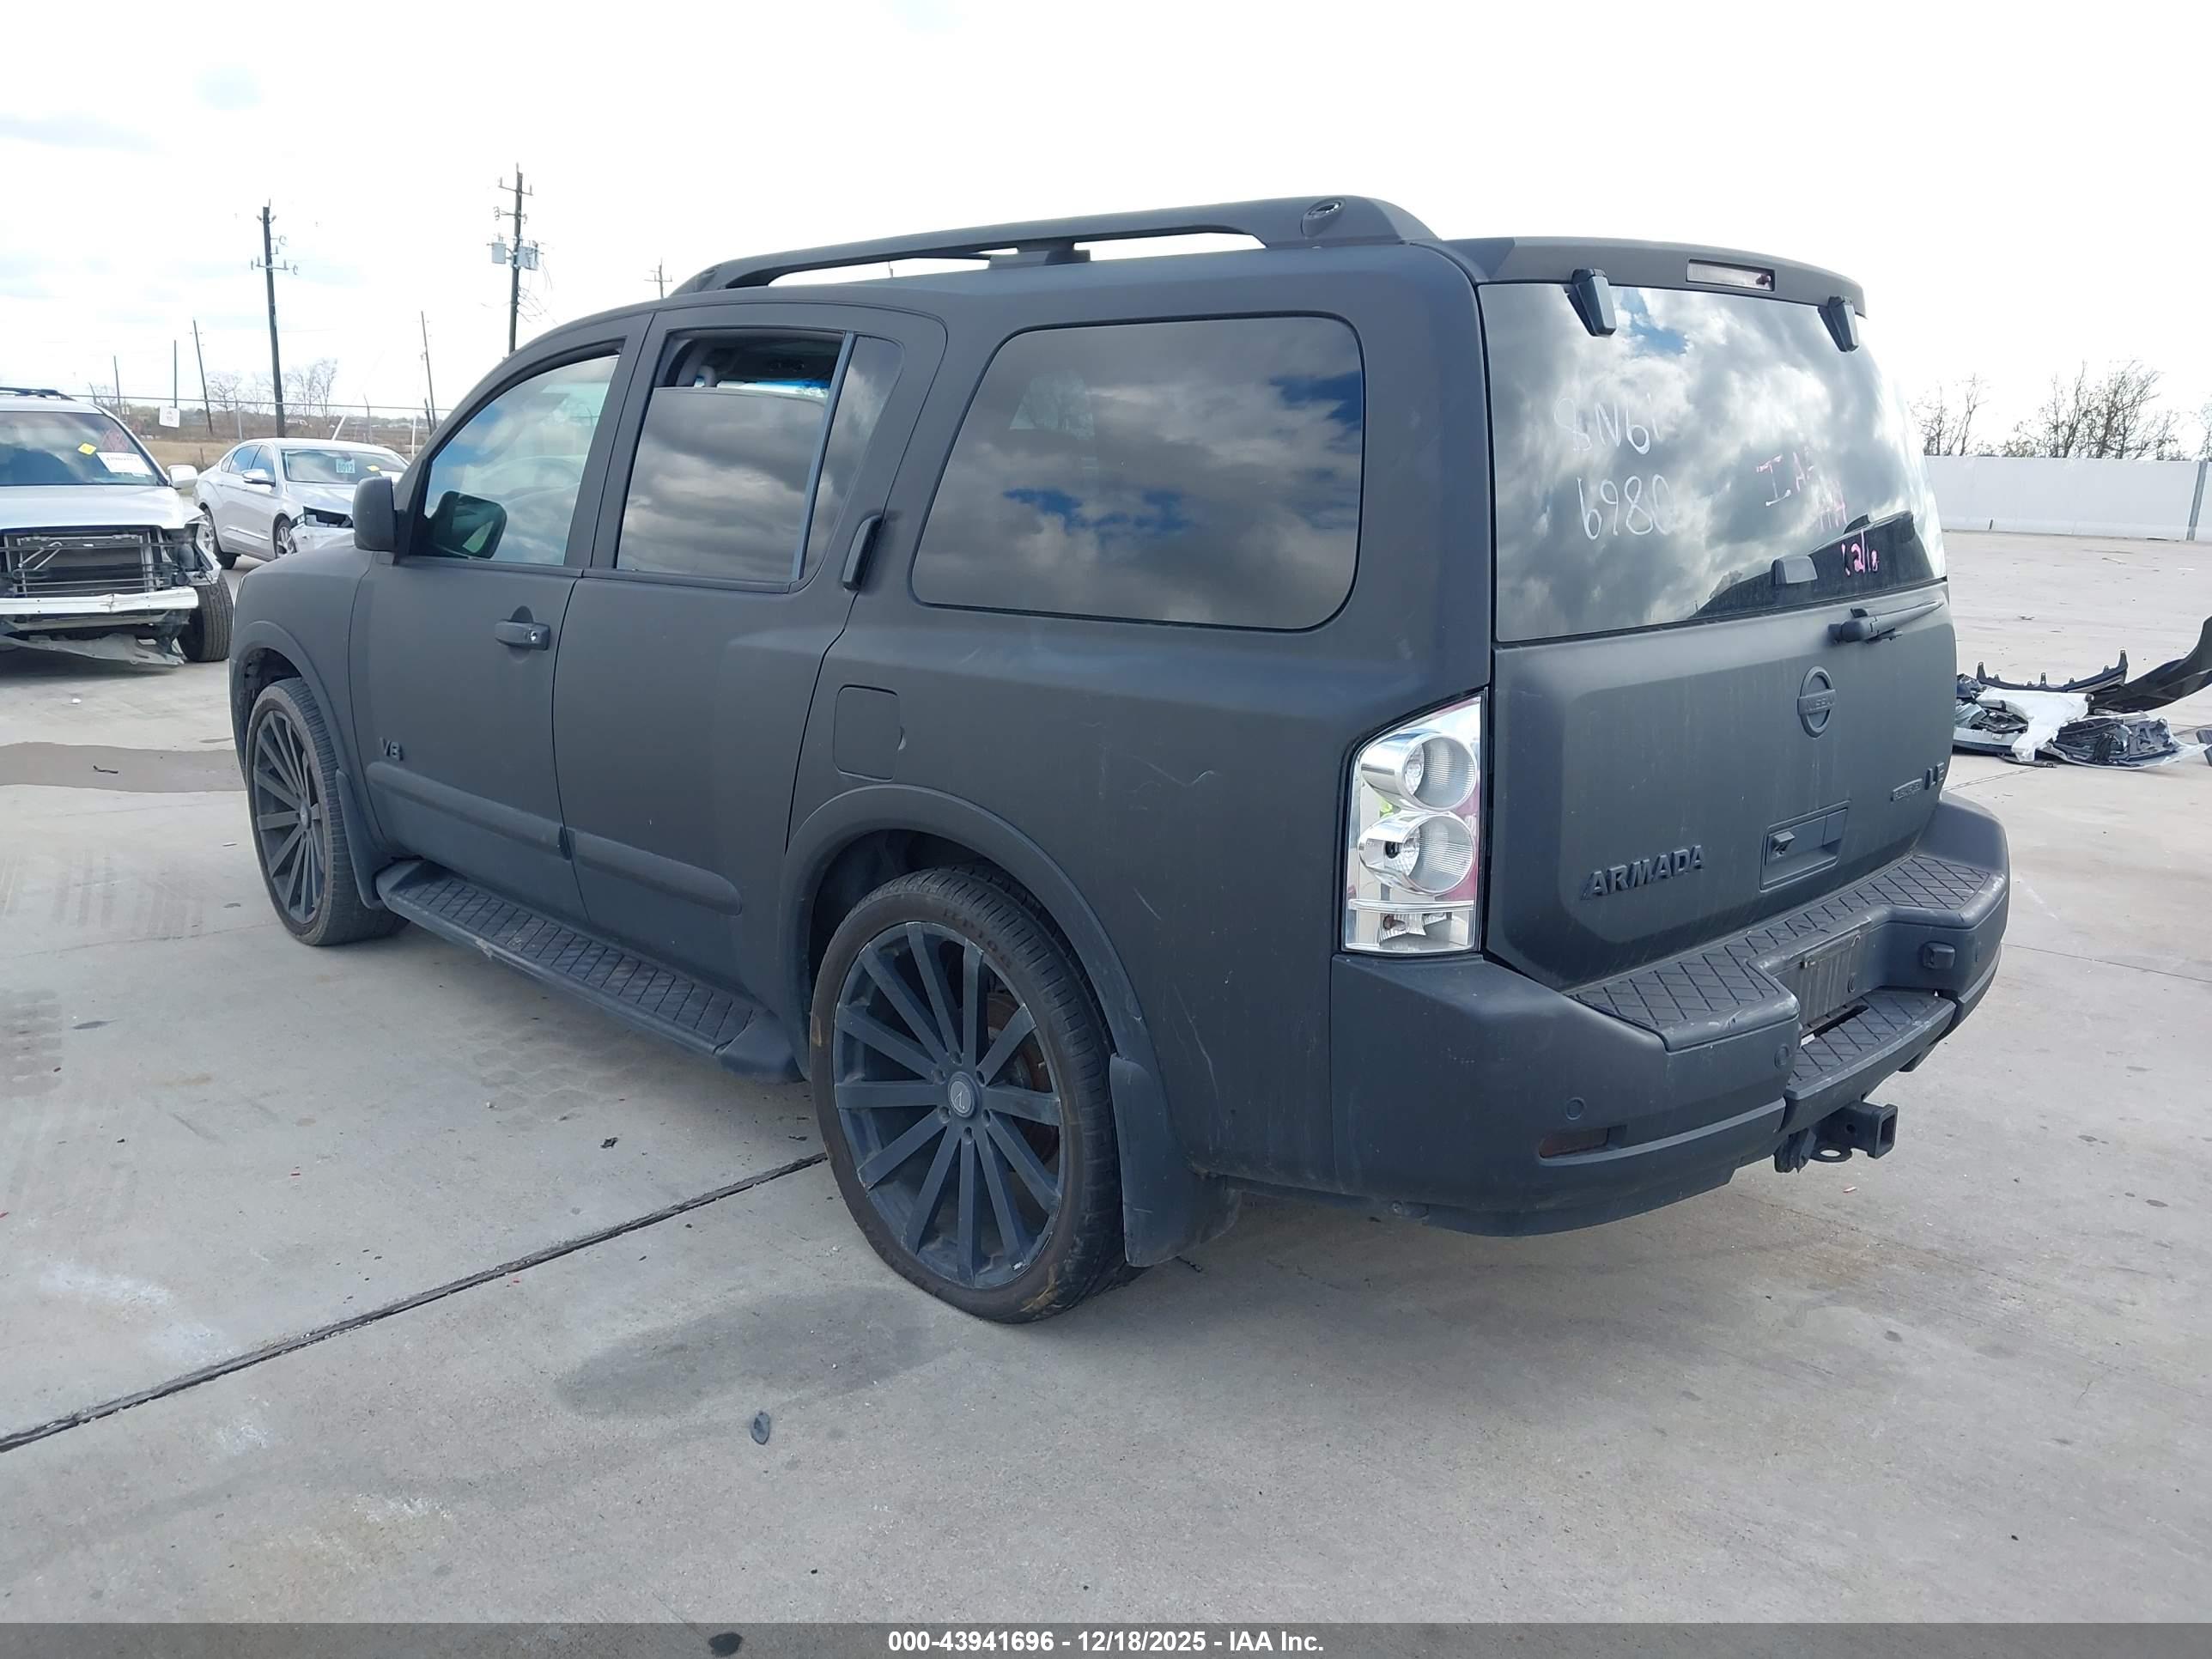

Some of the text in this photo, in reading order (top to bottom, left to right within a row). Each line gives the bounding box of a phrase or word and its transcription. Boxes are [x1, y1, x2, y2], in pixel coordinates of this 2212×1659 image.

[1577, 474, 1675, 540] 6980
[1923, 762, 1945, 790] LE
[1580, 844, 1705, 900] ARMADA
